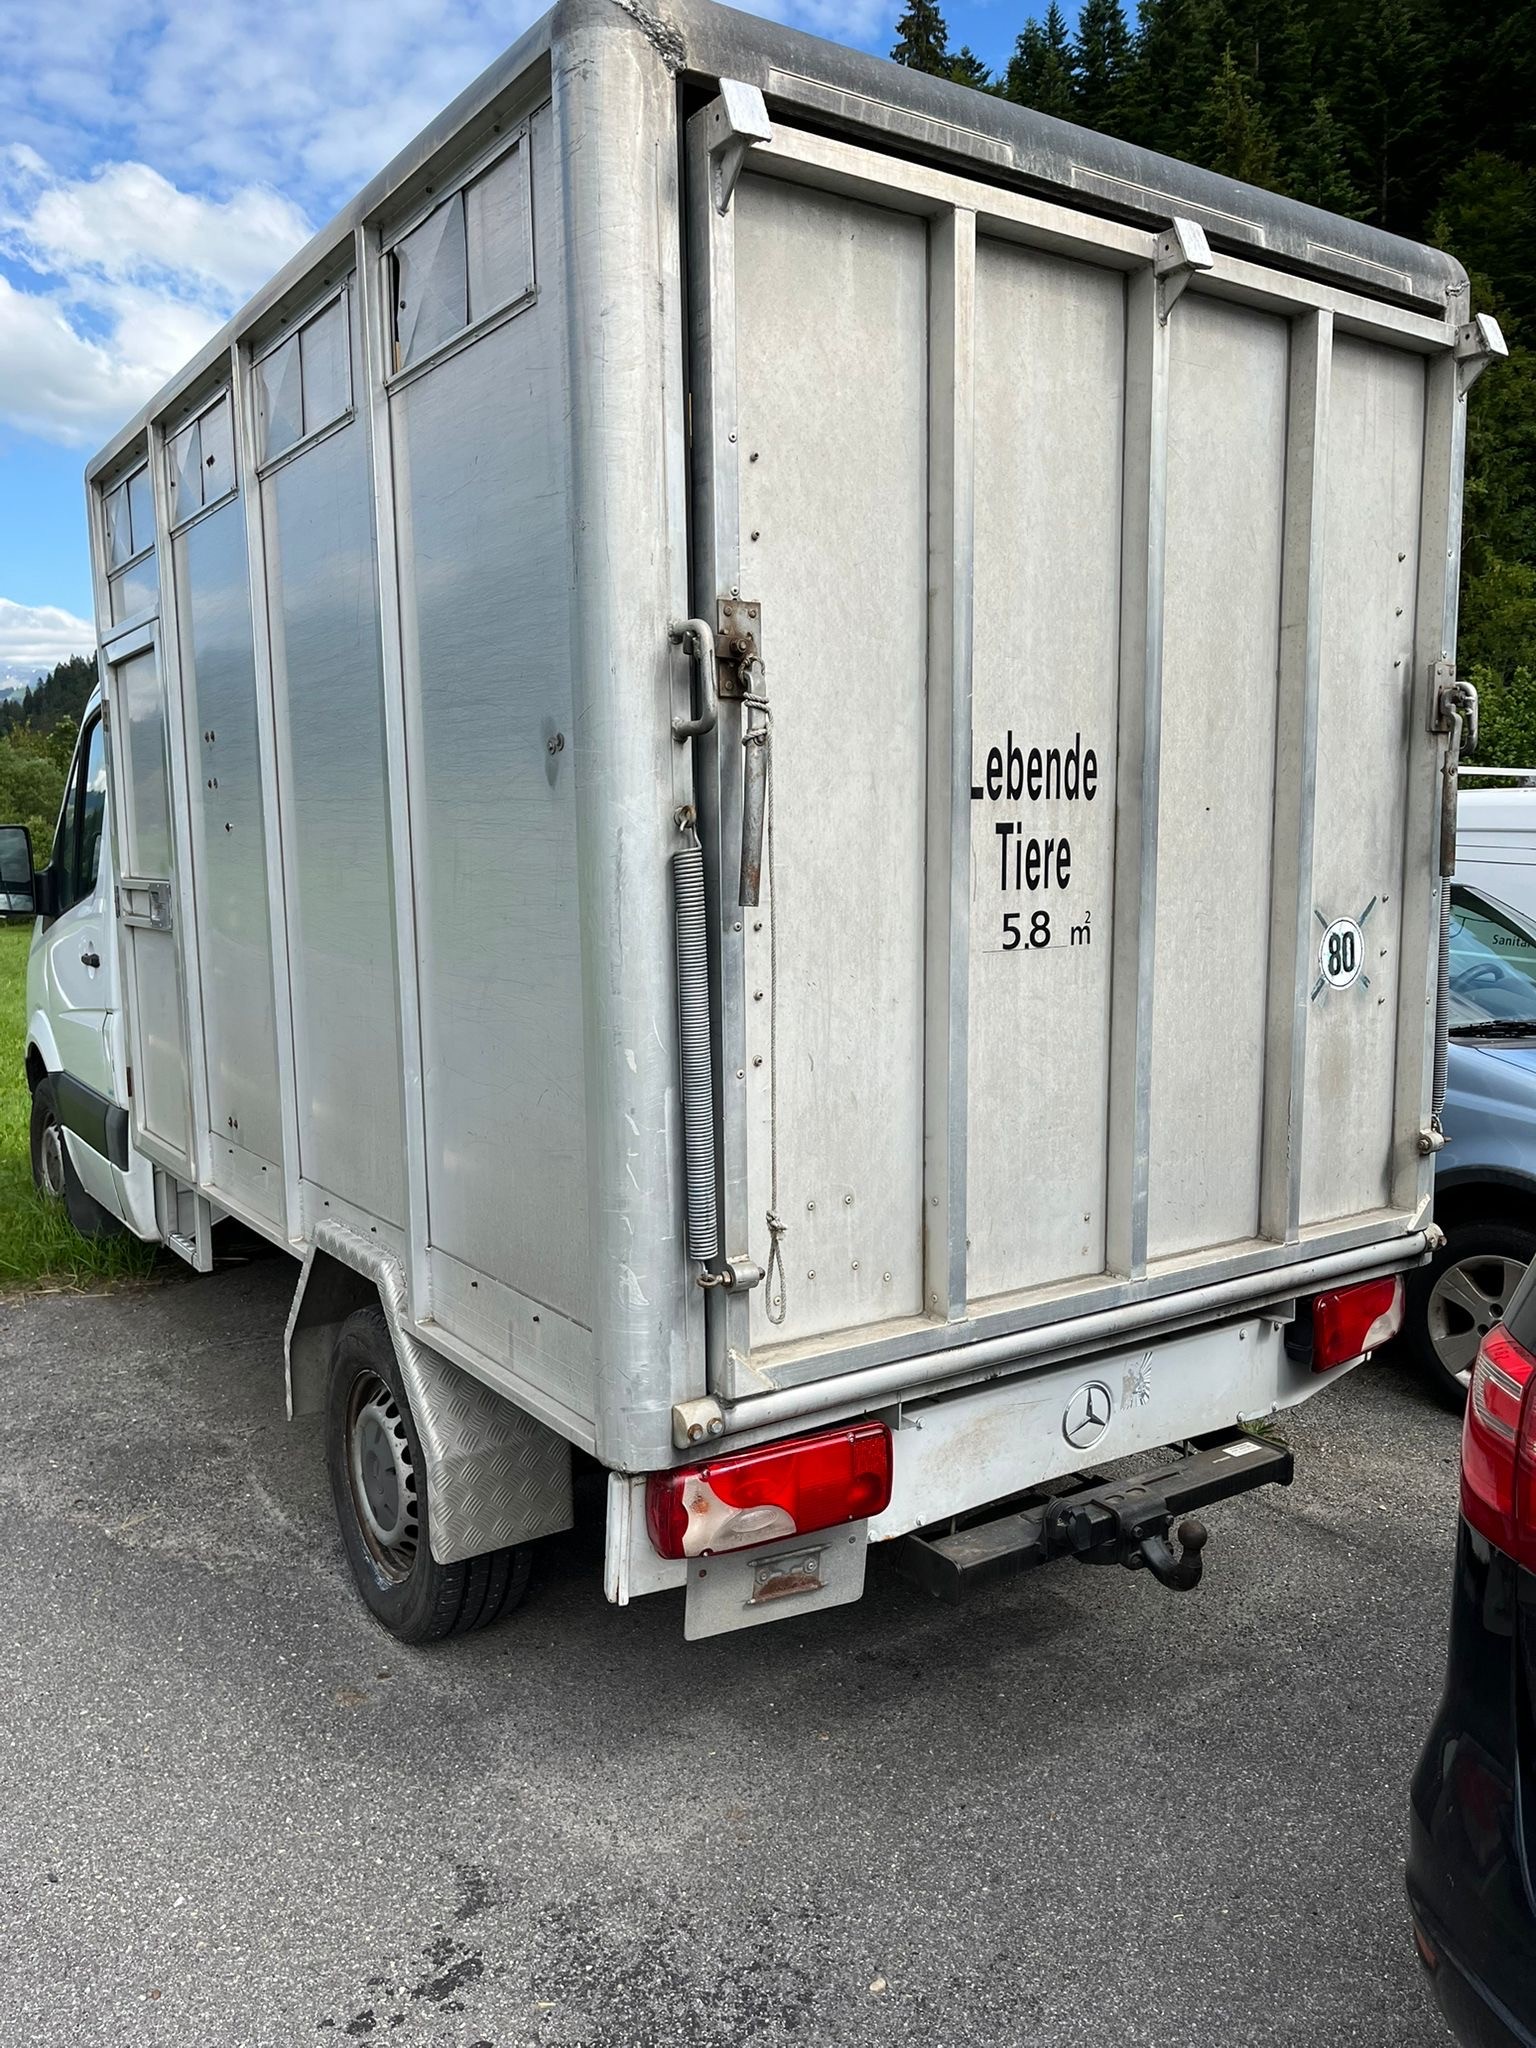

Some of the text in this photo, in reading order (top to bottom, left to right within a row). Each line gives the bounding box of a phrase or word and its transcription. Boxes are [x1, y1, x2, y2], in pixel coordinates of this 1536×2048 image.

[995, 821, 1071, 891] Tiere
[1002, 910, 1051, 950] 5.8
[1328, 931, 1355, 976] 80
